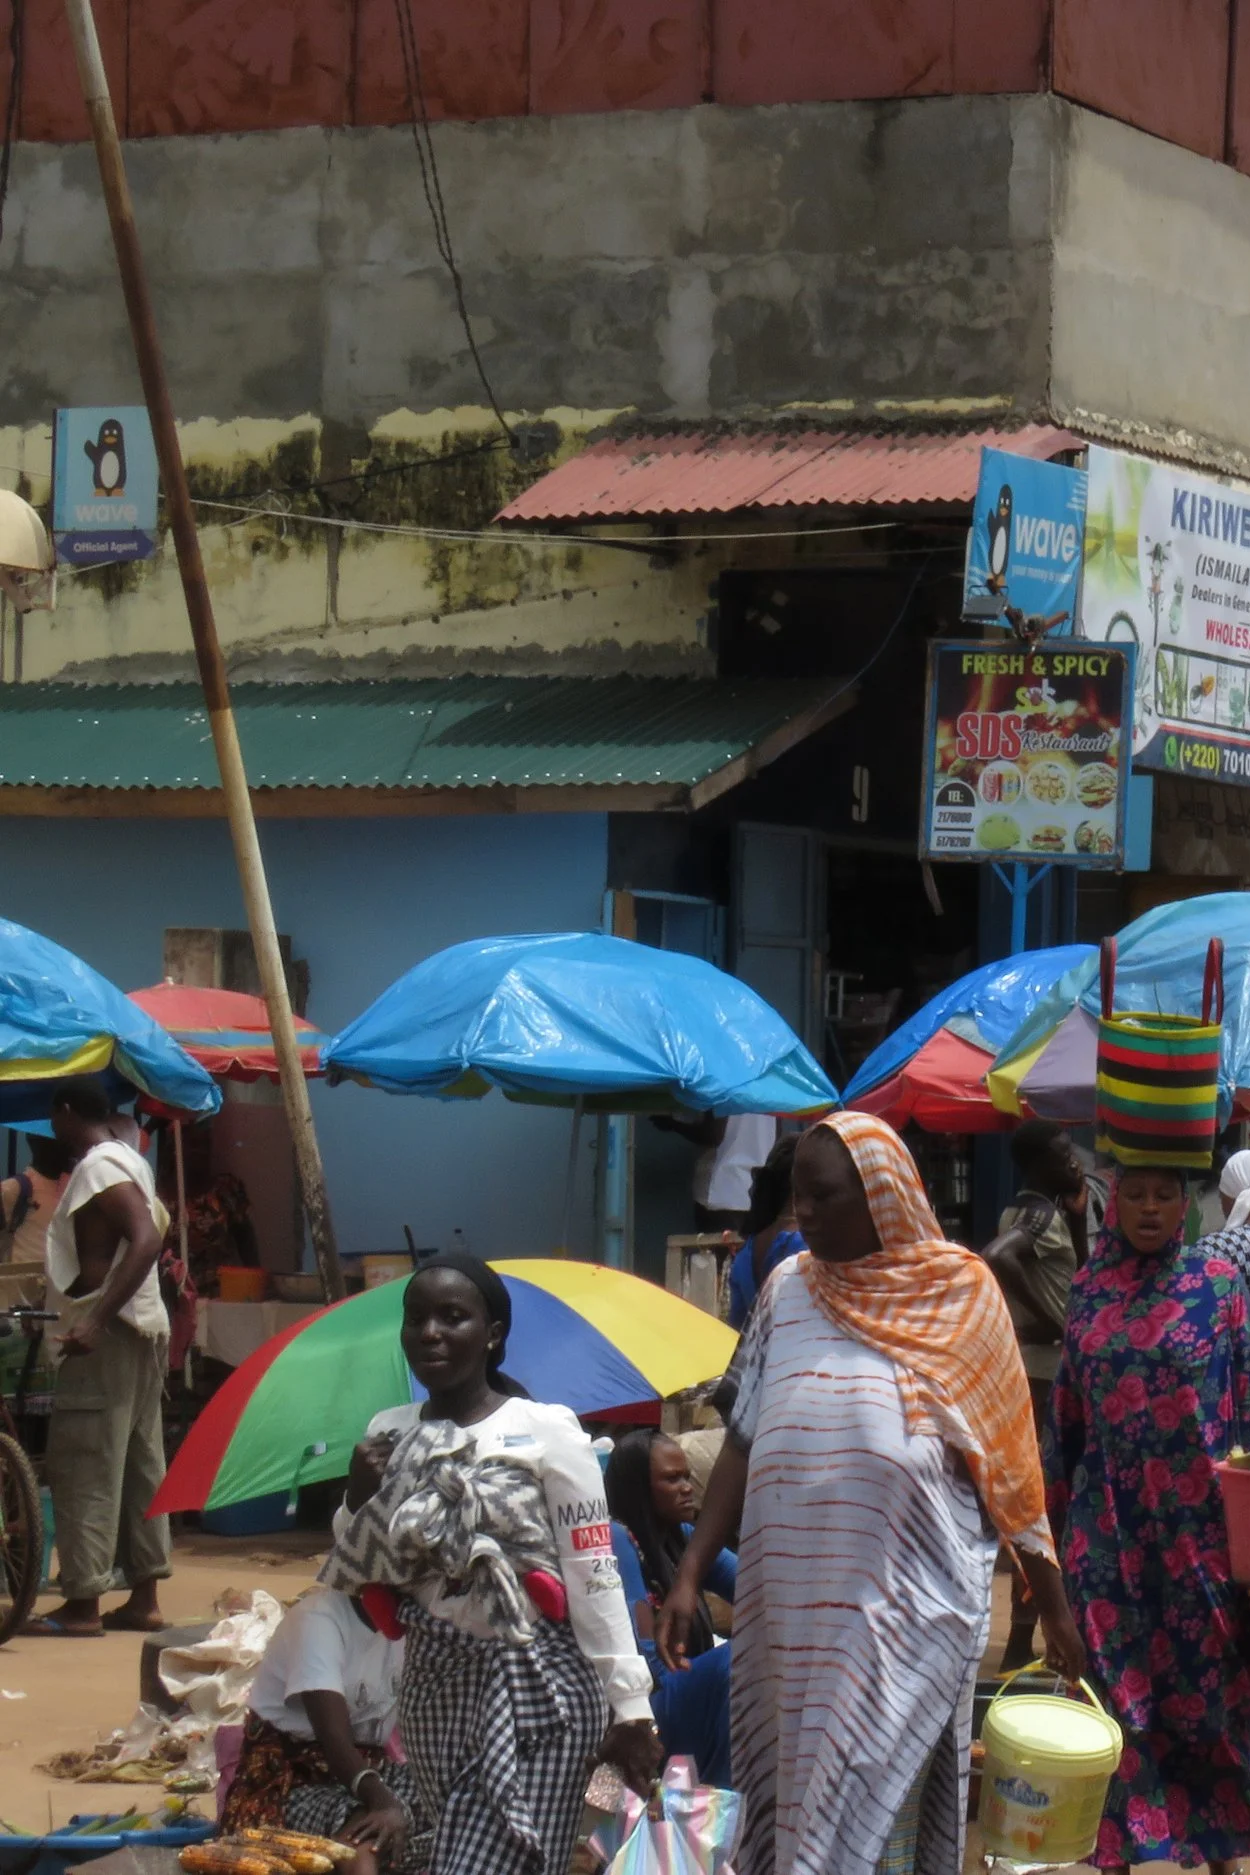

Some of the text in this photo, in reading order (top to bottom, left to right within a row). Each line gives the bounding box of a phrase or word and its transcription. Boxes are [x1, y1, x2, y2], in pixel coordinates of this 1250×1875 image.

[75, 503, 138, 522] wave
[73, 542, 138, 553] Official Agent
[1015, 514, 1076, 563] wave
[1195, 553, 1250, 589] (ISMAILA
[1191, 584, 1224, 608] Dealers
[1225, 592, 1231, 608] in
[962, 654, 1111, 677] FRESH & SPICY
[956, 712, 1113, 760] SDS Restaurant
[1179, 741, 1220, 775] (+220)
